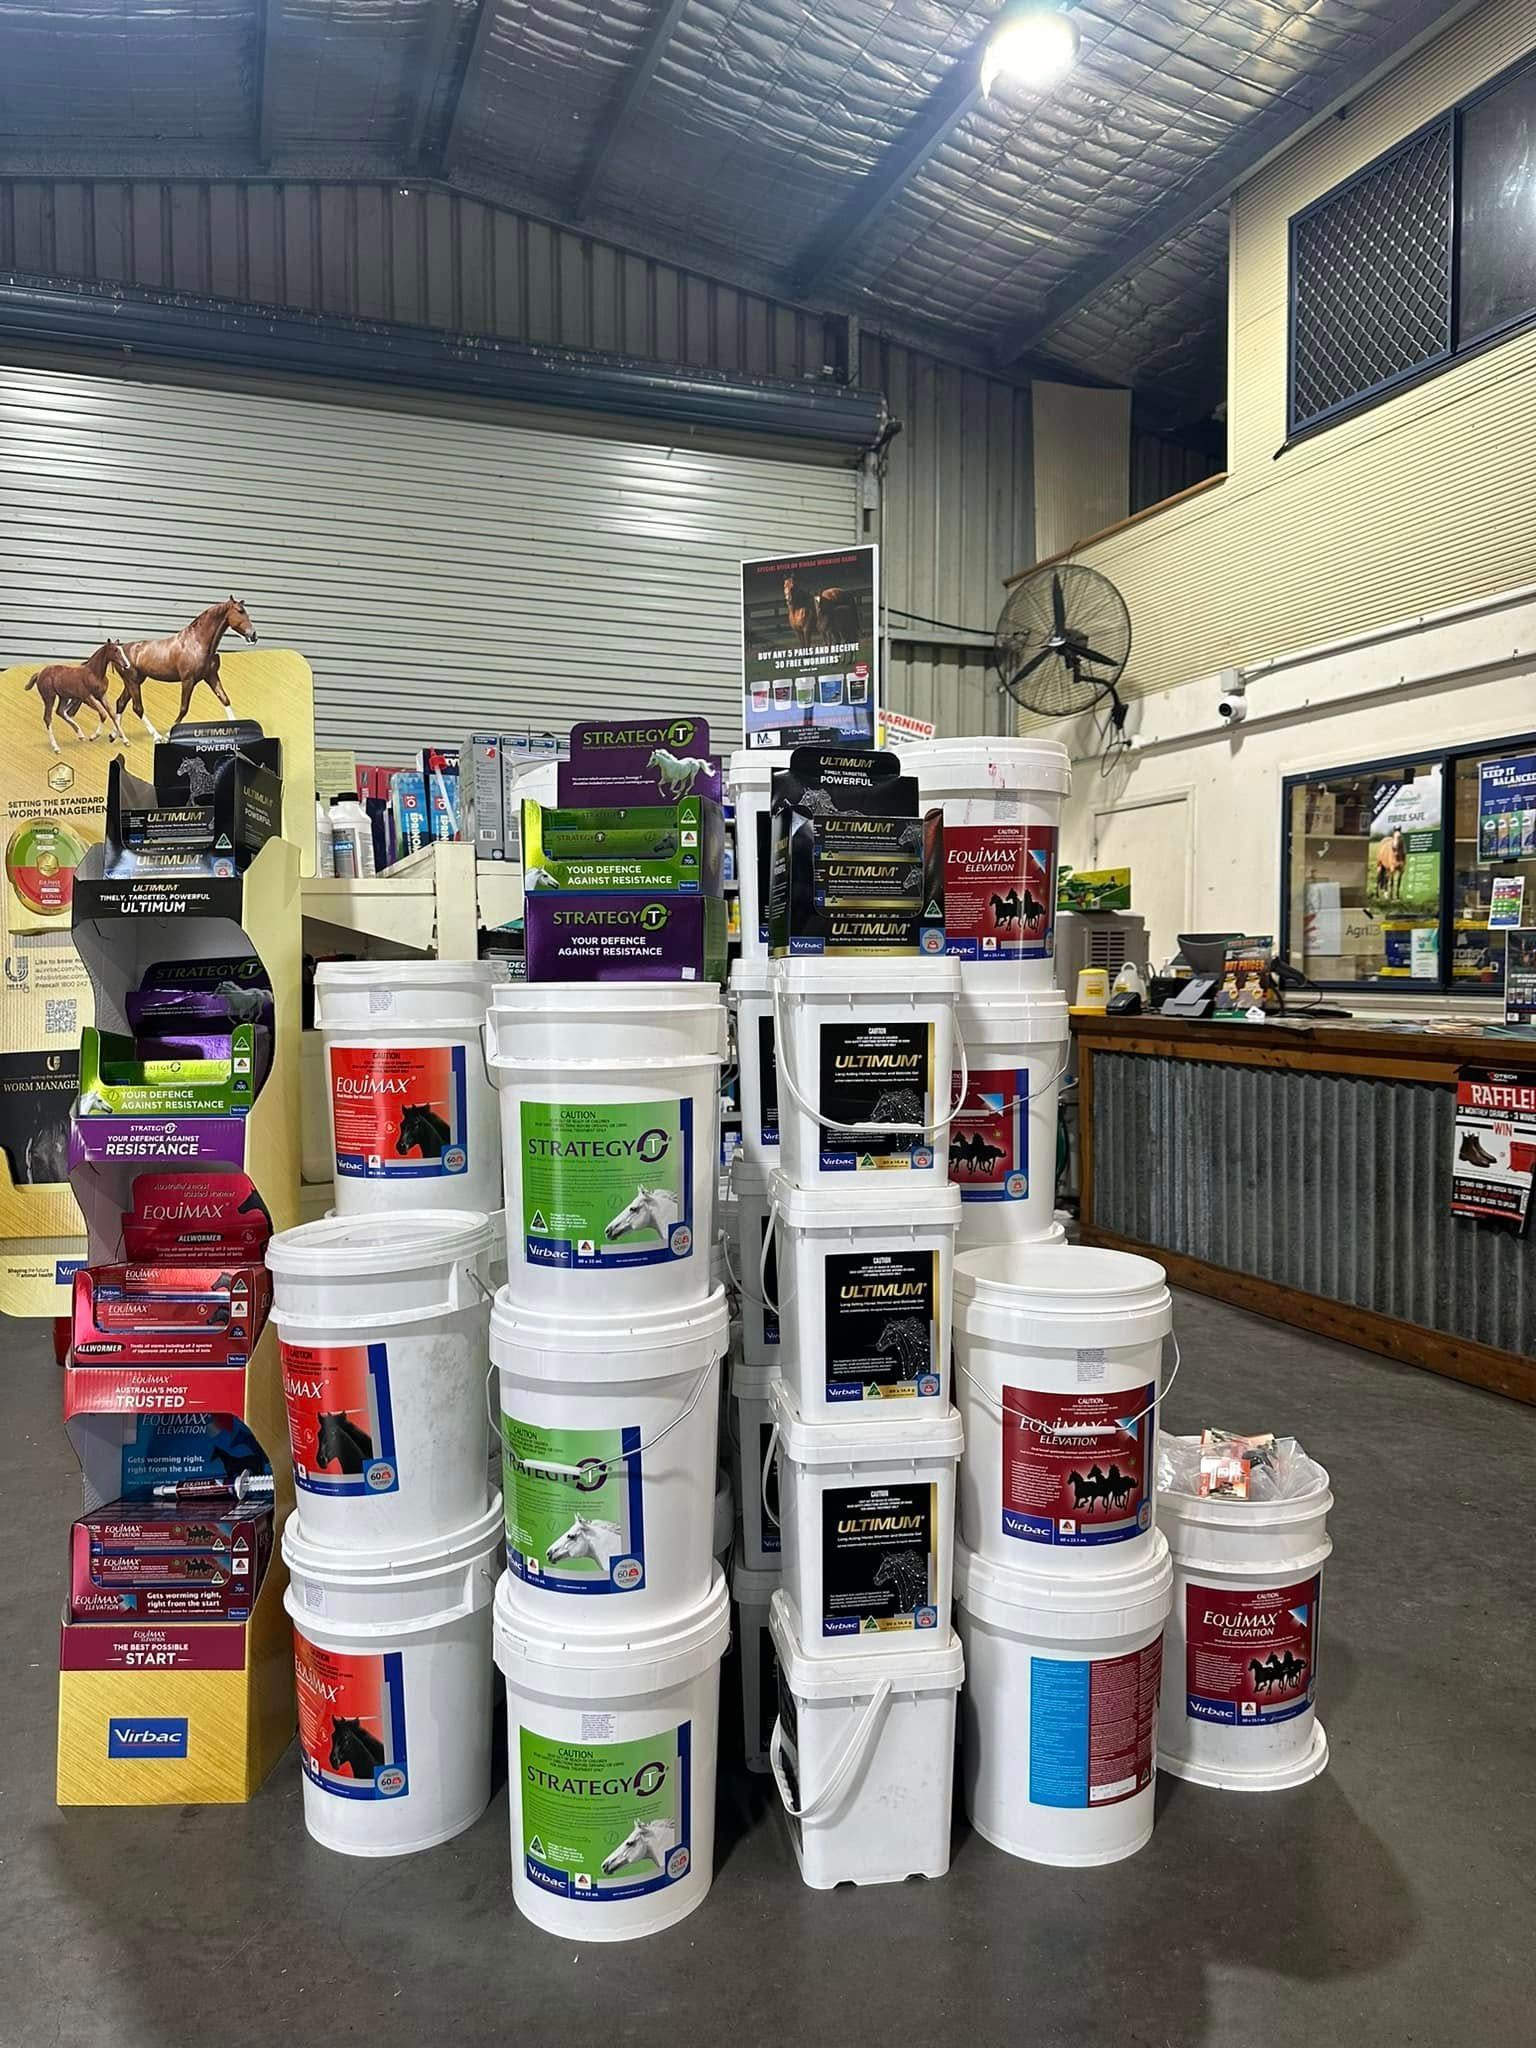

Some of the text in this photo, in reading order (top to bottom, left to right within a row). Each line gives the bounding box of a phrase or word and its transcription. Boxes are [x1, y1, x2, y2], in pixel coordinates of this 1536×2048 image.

[758, 642, 860, 660] BUY ANY 5 PAILS AND RECEIVE
[775, 656, 838, 669] 30 FREE WORMERS
[879, 711, 933, 735] WARNING
[193, 727, 240, 737] ULTIMUM
[583, 727, 687, 745] STRATEGY T
[195, 743, 241, 753] POWERFUL
[820, 756, 875, 768] ULTIMUM
[1482, 767, 1516, 779] KEEP IT
[820, 776, 873, 787] POWERFUL
[8, 800, 41, 809] SETTING
[59, 797, 104, 806] STANDARD
[8, 809, 41, 818] WORM
[147, 811, 204, 822] ULTIMUM
[825, 821, 894, 833] ULTIMUM
[136, 854, 202, 866] ULTIMUM
[567, 865, 641, 874] YOUR DEFENCE
[828, 865, 898, 877] ULTIMUM
[965, 864, 1015, 872] ELEVATION
[567, 876, 673, 885] AGAINST RESISTANCE
[132, 884, 180, 892] ULTIMUM
[100, 893, 210, 902] TIMELY, TARGETED, POWERFUL
[120, 902, 186, 913] ULTIMUM
[553, 910, 660, 925] STRATEGY T
[831, 922, 911, 935] ULTIMUM
[571, 936, 646, 945] YOUR DEFENCE
[791, 941, 822, 949] Virbac
[558, 947, 663, 956] AGAINST RESISTANCE
[156, 964, 240, 980] STRATEGY
[835, 1054, 919, 1069] ULTIMUM
[4, 1081, 33, 1092] WORM
[121, 1090, 193, 1099] YOUR DEFENCE
[1470, 1084, 1535, 1109] RAFFLE!
[121, 1101, 224, 1110] AGAINST RESISTANCE
[560, 1110, 596, 1119] CAUTION
[1493, 1122, 1512, 1137] WIN
[105, 1143, 199, 1155] RESISTANCE
[528, 1137, 661, 1158] STRATEGY T
[337, 1159, 363, 1170] Virbac
[822, 1158, 855, 1166] Virbac
[143, 1202, 224, 1220] EQUiMAX
[178, 1234, 222, 1242] ALLWORMER
[528, 1243, 569, 1260] Virbac
[59, 1266, 79, 1276] Vir
[840, 1283, 924, 1299] ULTIMUM
[77, 1344, 122, 1353] ALLWORMER
[132, 1375, 170, 1384] EQUiMAX
[166, 1386, 188, 1394] MOST
[828, 1388, 861, 1396] Virbac
[116, 1395, 185, 1408] TRUSTED
[156, 1425, 207, 1435] ELEVATION
[513, 1425, 538, 1441] CAUTION
[1039, 1435, 1098, 1446] ELEVATION
[127, 1455, 205, 1465] Gets worming right,
[127, 1465, 203, 1474] right from the start
[104, 1523, 142, 1533] EQUiMAX
[837, 1515, 921, 1534] ULTIMUM
[1004, 1516, 1051, 1536] Virbac
[103, 1557, 140, 1567] EQUiMAX
[74, 1593, 119, 1606] EQUiMAX
[165, 1592, 199, 1601] worming
[200, 1592, 222, 1600] right,
[1256, 1592, 1279, 1600] CAUTION
[147, 1600, 165, 1609] right
[167, 1600, 186, 1608] from
[1203, 1610, 1278, 1628] EQUiMAX
[825, 1622, 857, 1631] Virbac
[134, 1630, 166, 1638] EQUiMAX
[1222, 1627, 1275, 1638] ELEVATION
[125, 1652, 176, 1665] START
[1190, 1700, 1234, 1718] Virbac
[114, 1728, 183, 1745] Virbac
[558, 1747, 594, 1759] CAUTION
[381, 1778, 392, 1786] 60
[527, 1765, 657, 1796] STRATEGY T
[528, 1862, 567, 1890] Virbac
